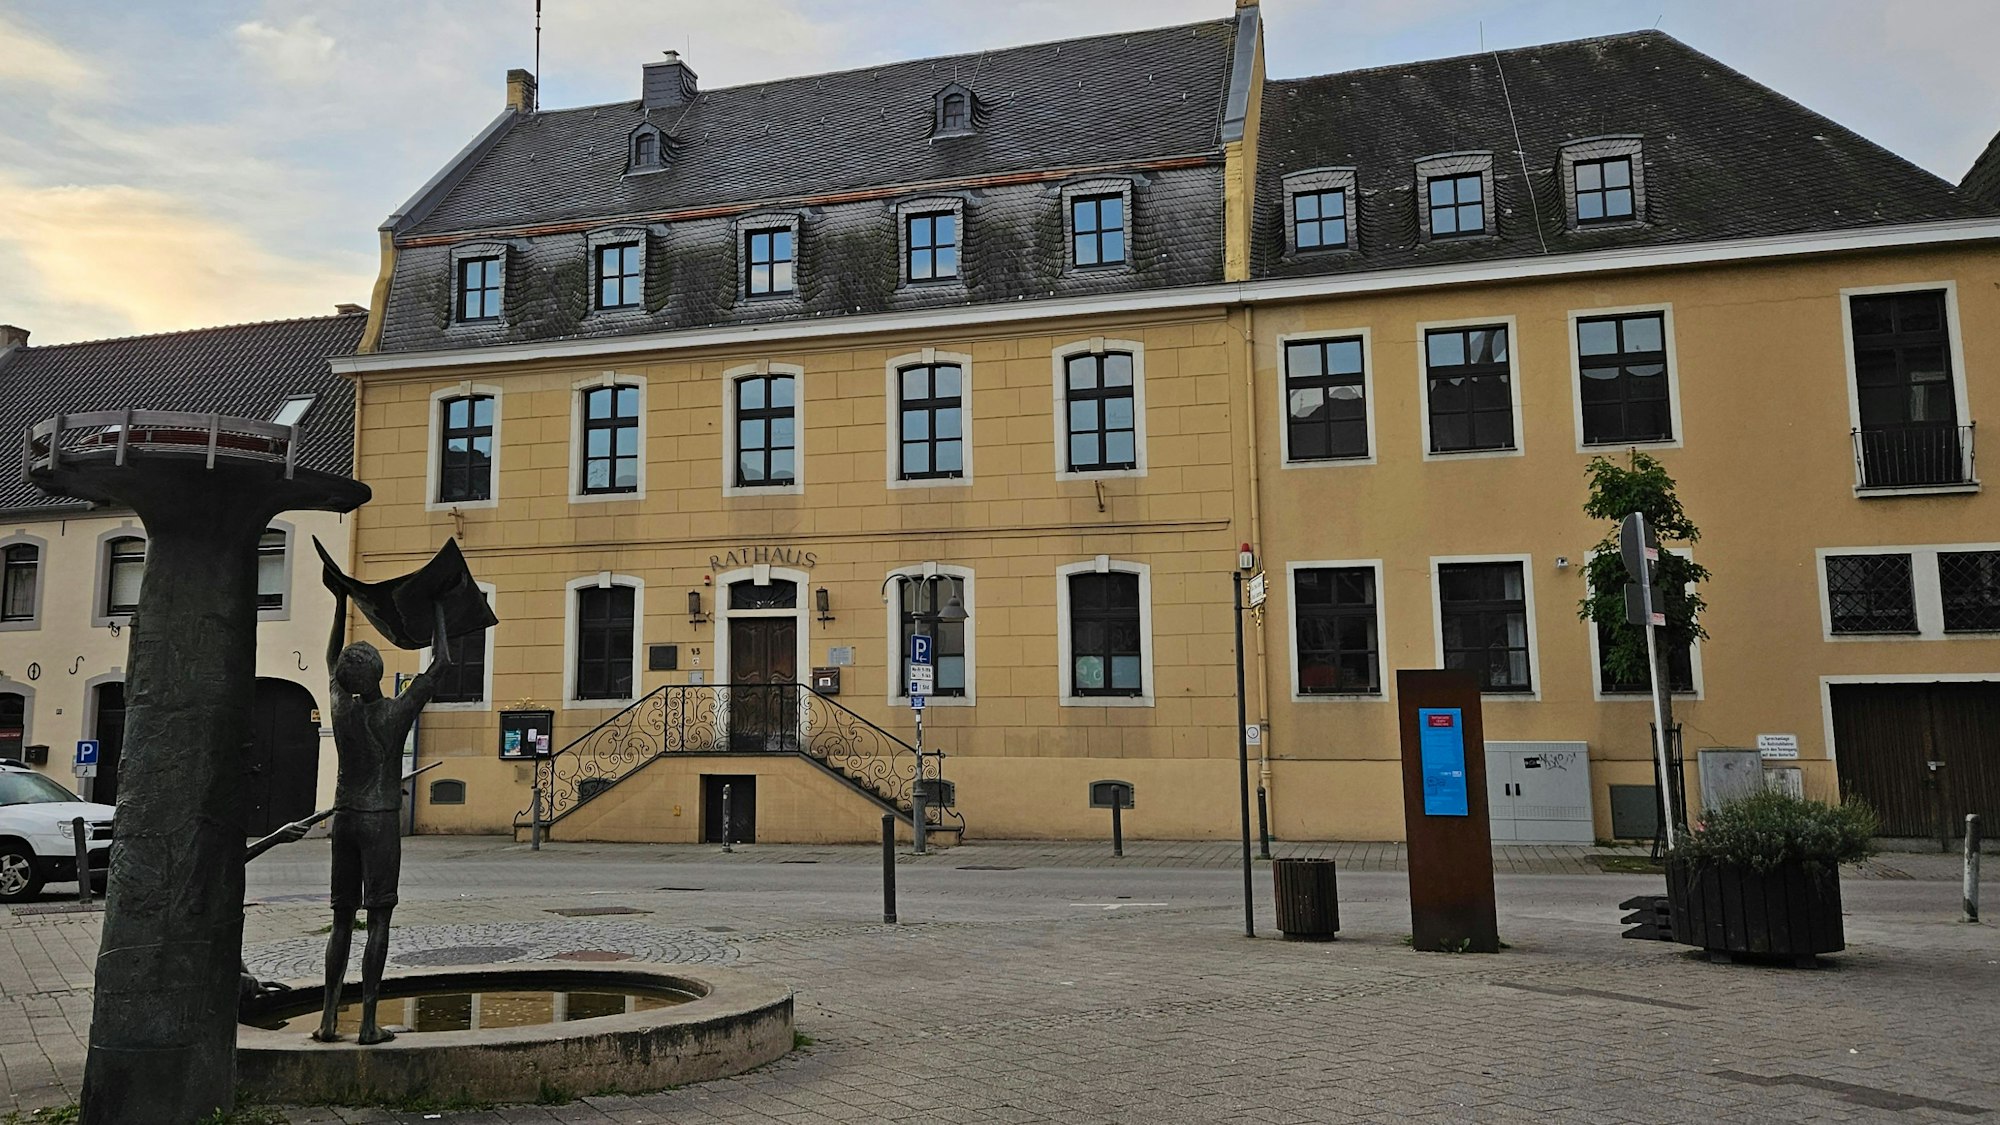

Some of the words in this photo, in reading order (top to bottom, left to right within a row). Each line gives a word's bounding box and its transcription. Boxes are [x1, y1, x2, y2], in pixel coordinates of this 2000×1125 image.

[709, 546, 817, 571] RATHAUS
[916, 639, 927, 661] P
[81, 743, 94, 761] P
